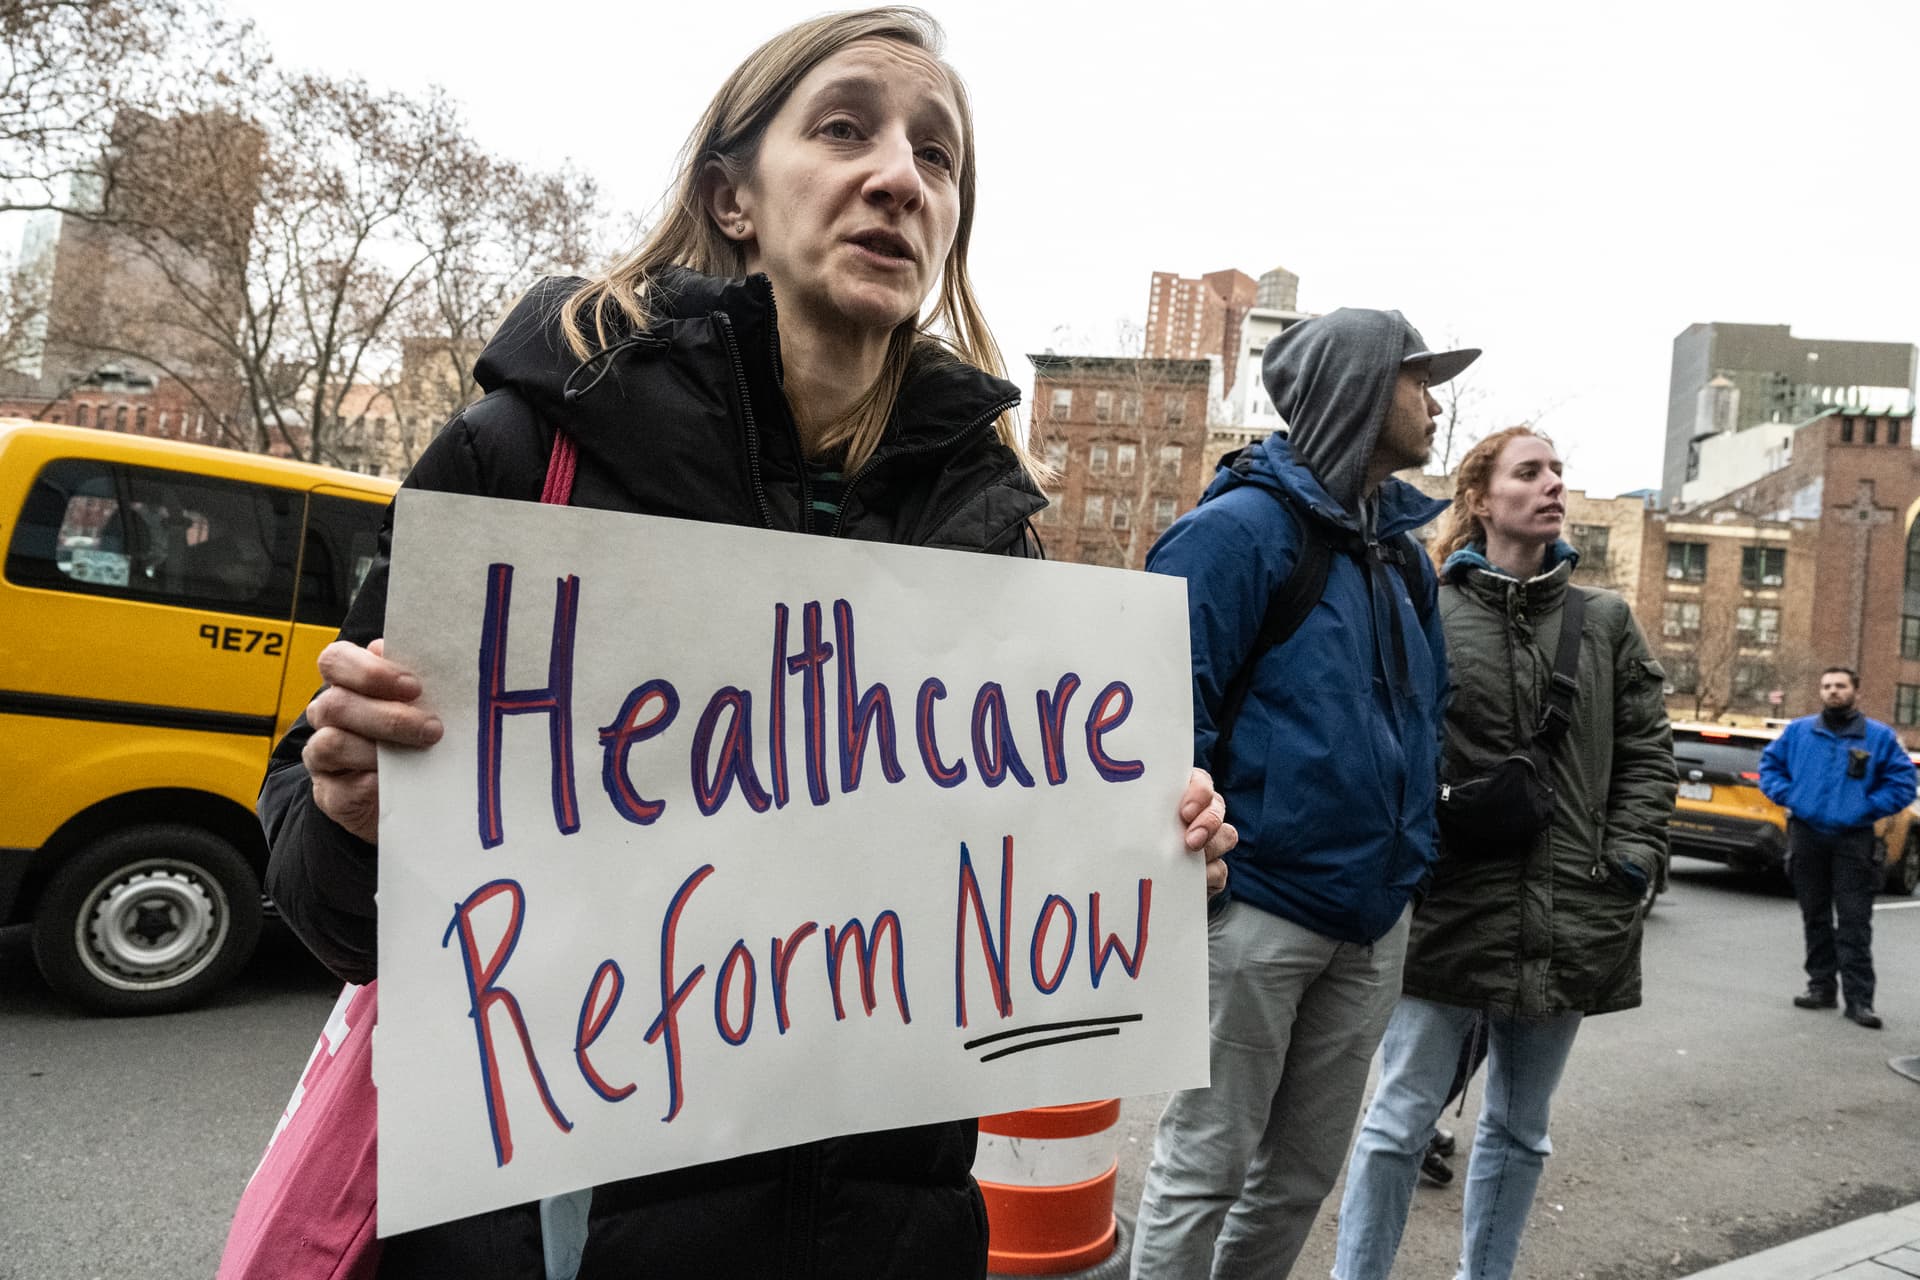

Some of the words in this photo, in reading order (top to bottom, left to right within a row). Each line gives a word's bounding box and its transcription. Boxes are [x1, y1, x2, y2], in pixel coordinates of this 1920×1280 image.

[199, 623, 284, 657] 9E72
[478, 563, 1145, 851] Healthcare
[442, 864, 913, 1168] Reform
